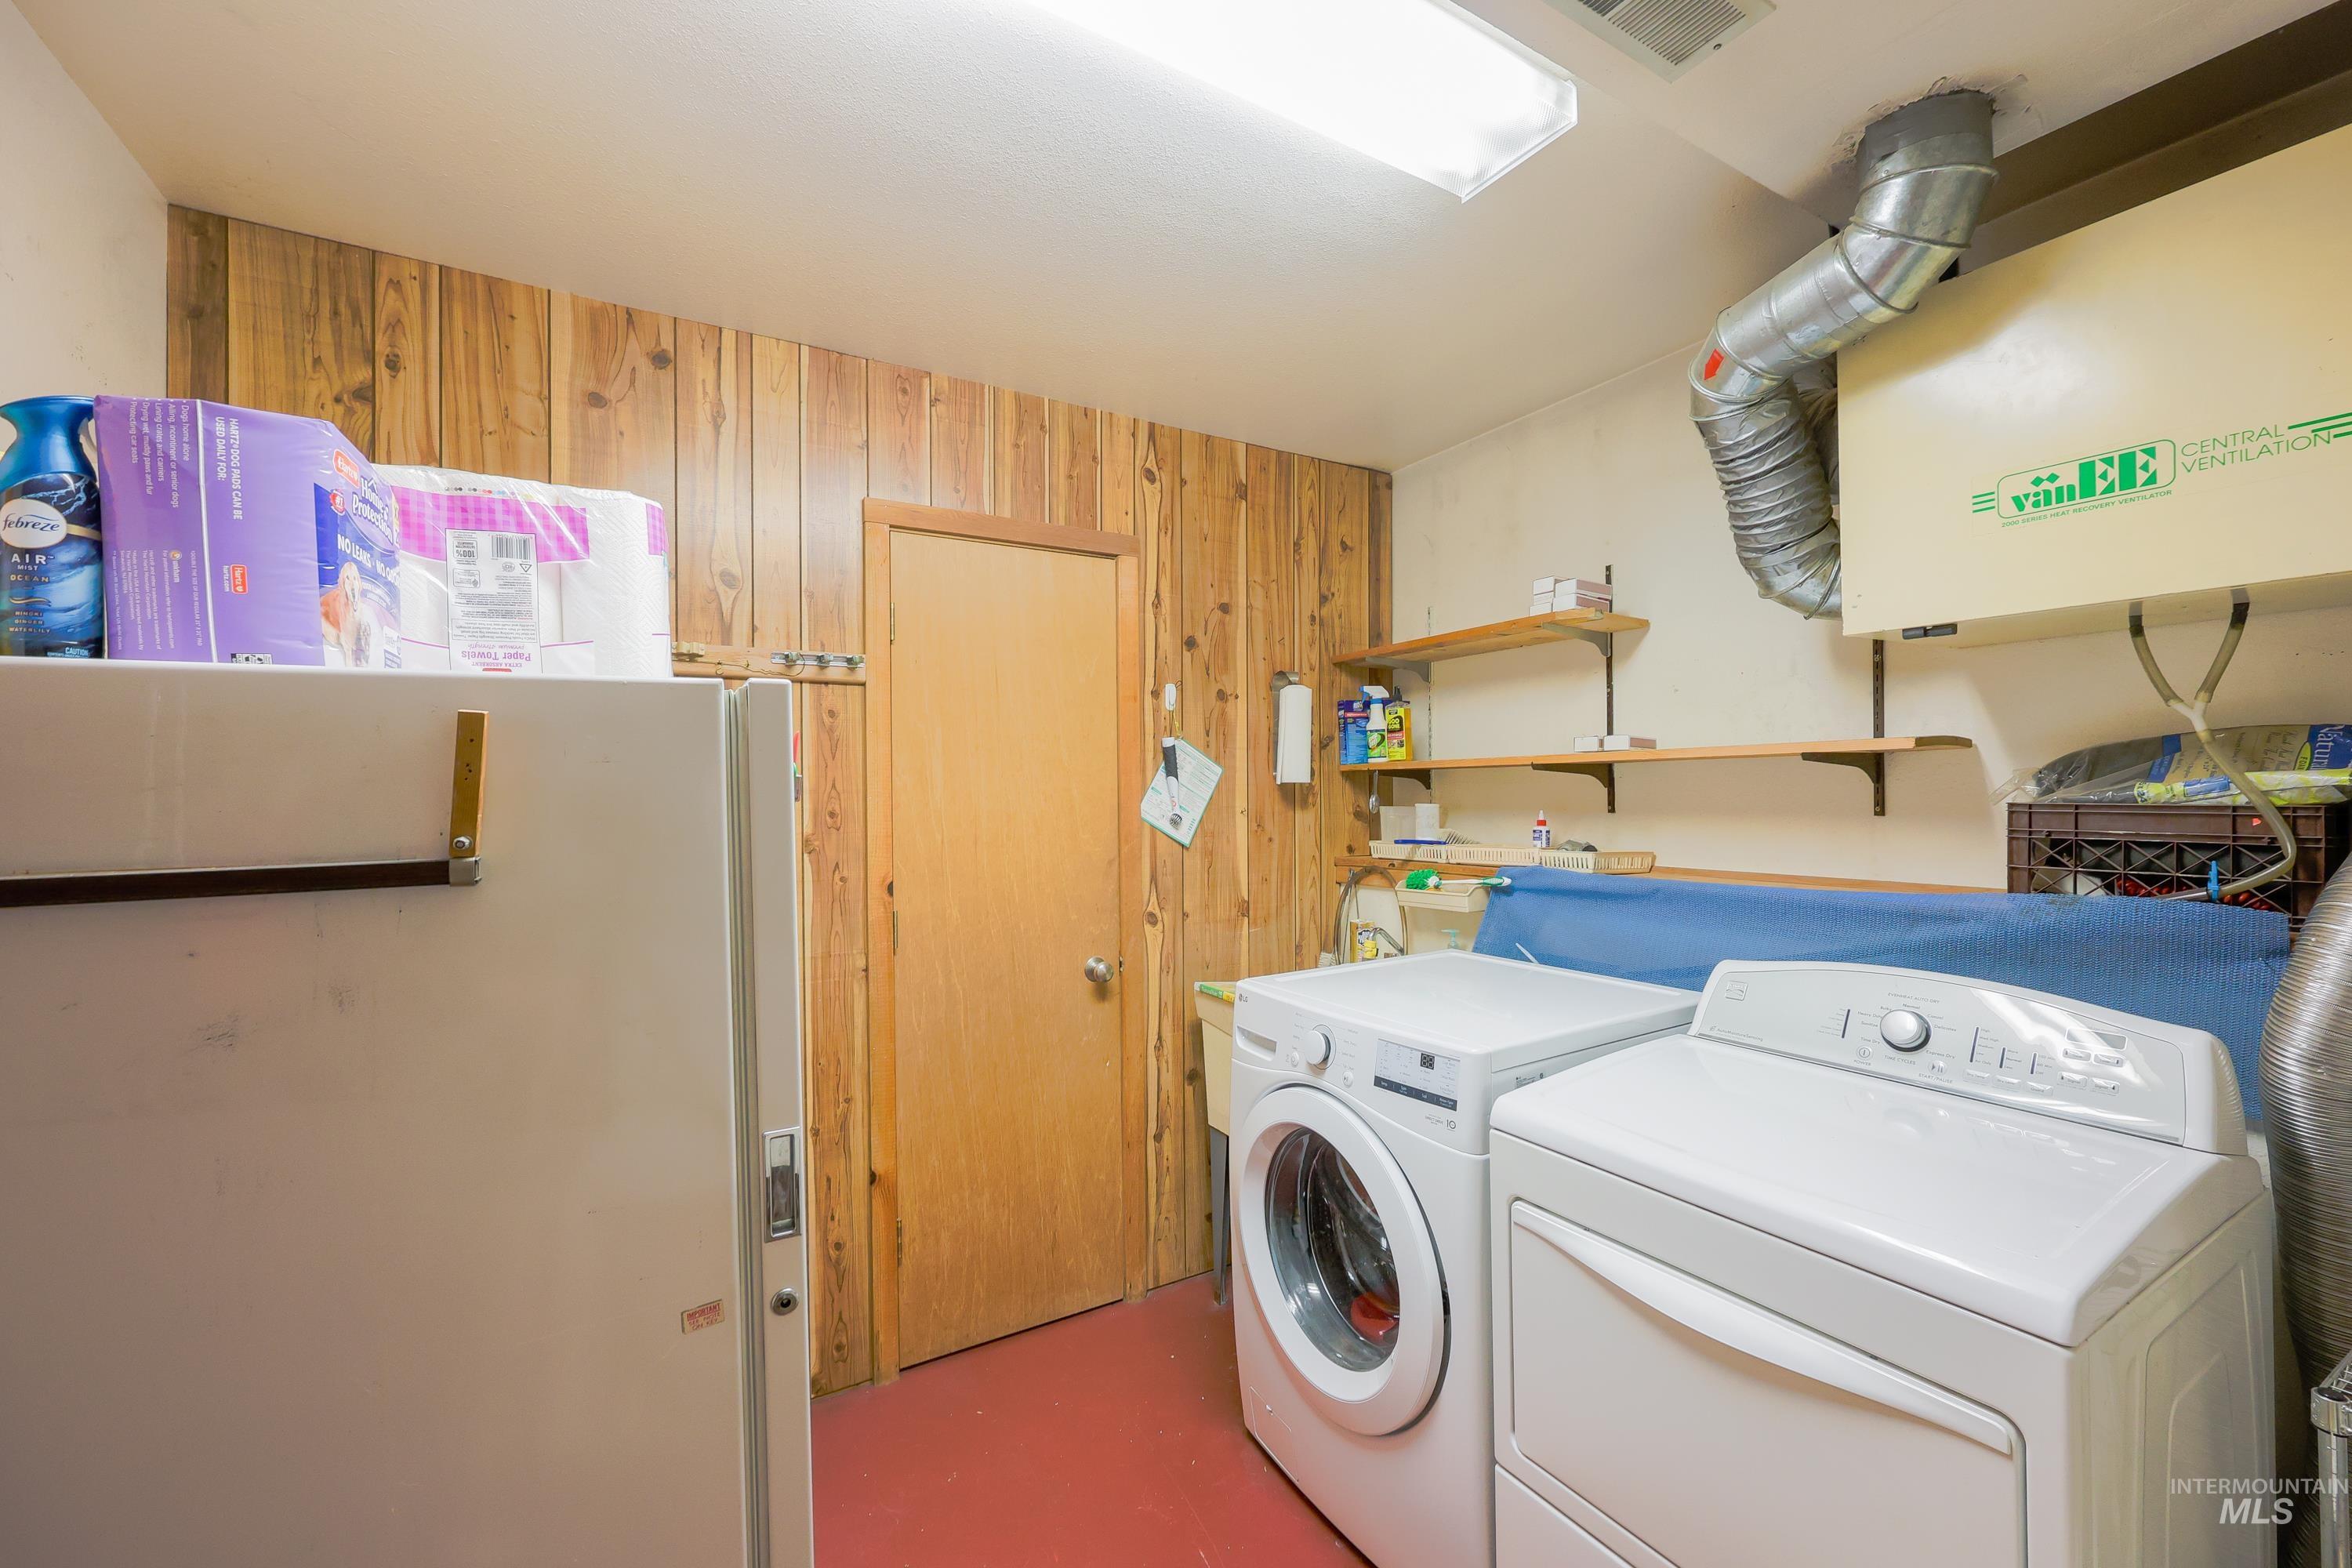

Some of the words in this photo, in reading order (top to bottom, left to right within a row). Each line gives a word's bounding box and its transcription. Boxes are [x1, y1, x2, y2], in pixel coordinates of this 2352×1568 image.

[216, 417, 226, 437] USED
[143, 436, 151, 456] muddy
[216, 439, 226, 459] DAILY
[2181, 424, 2285, 457] CENTRAL
[230, 448, 240, 466] DOG
[2181, 430, 2332, 473] VENTILATION
[217, 463, 227, 481] FOR:
[231, 469, 241, 488] PADS
[170, 492, 180, 508] dogs
[233, 491, 241, 507] CAN
[361, 477, 383, 511] Home
[234, 510, 242, 520] BE
[2020, 514, 2048, 524] SERIES
[2050, 510, 2071, 519] HEAT
[2072, 501, 2115, 515] RECOVERY
[2118, 489, 2172, 506] VENTILATOR
[2, 514, 60, 532] febreze
[353, 494, 393, 544] Protection
[337, 534, 350, 554] NO
[353, 543, 371, 568] LEAKS
[376, 560, 385, 577] NO
[10, 574, 49, 583] OCEAN
[234, 568, 245, 585] Hartz
[65, 647, 89, 656] CAUTION
[461, 651, 499, 660] Towels
[503, 652, 531, 661] Paper
[687, 1303, 720, 1322] IMPORTANT
